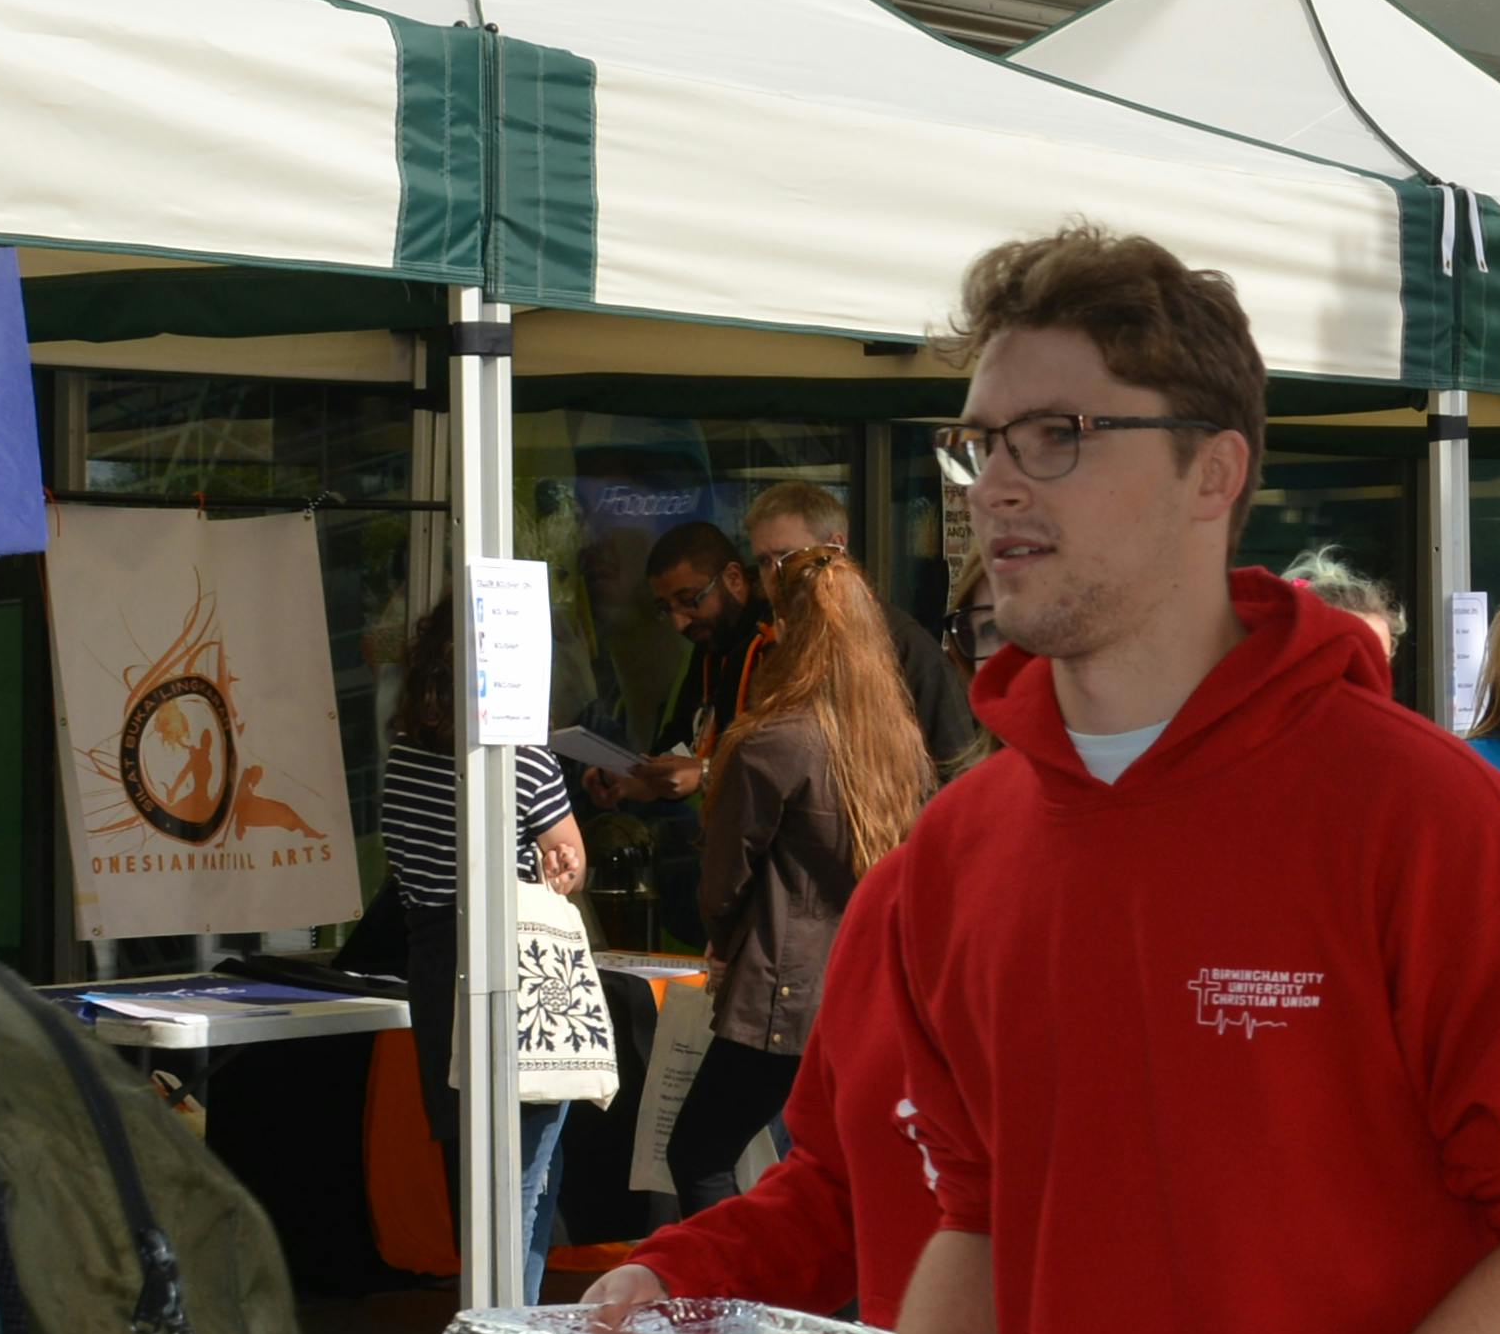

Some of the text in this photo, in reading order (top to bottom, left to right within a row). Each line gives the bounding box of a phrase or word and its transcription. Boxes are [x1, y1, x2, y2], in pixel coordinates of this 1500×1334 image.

[126, 699, 159, 749] BUKA
[124, 758, 156, 814] SILAT
[201, 852, 256, 871] MARTIAL
[271, 843, 332, 868] ARTS
[1211, 967, 1325, 984] BIRMINGHAM CITY
[1227, 982, 1304, 996] UNIVERSITY
[1211, 993, 1321, 1008] CHRISTIAN UNION
